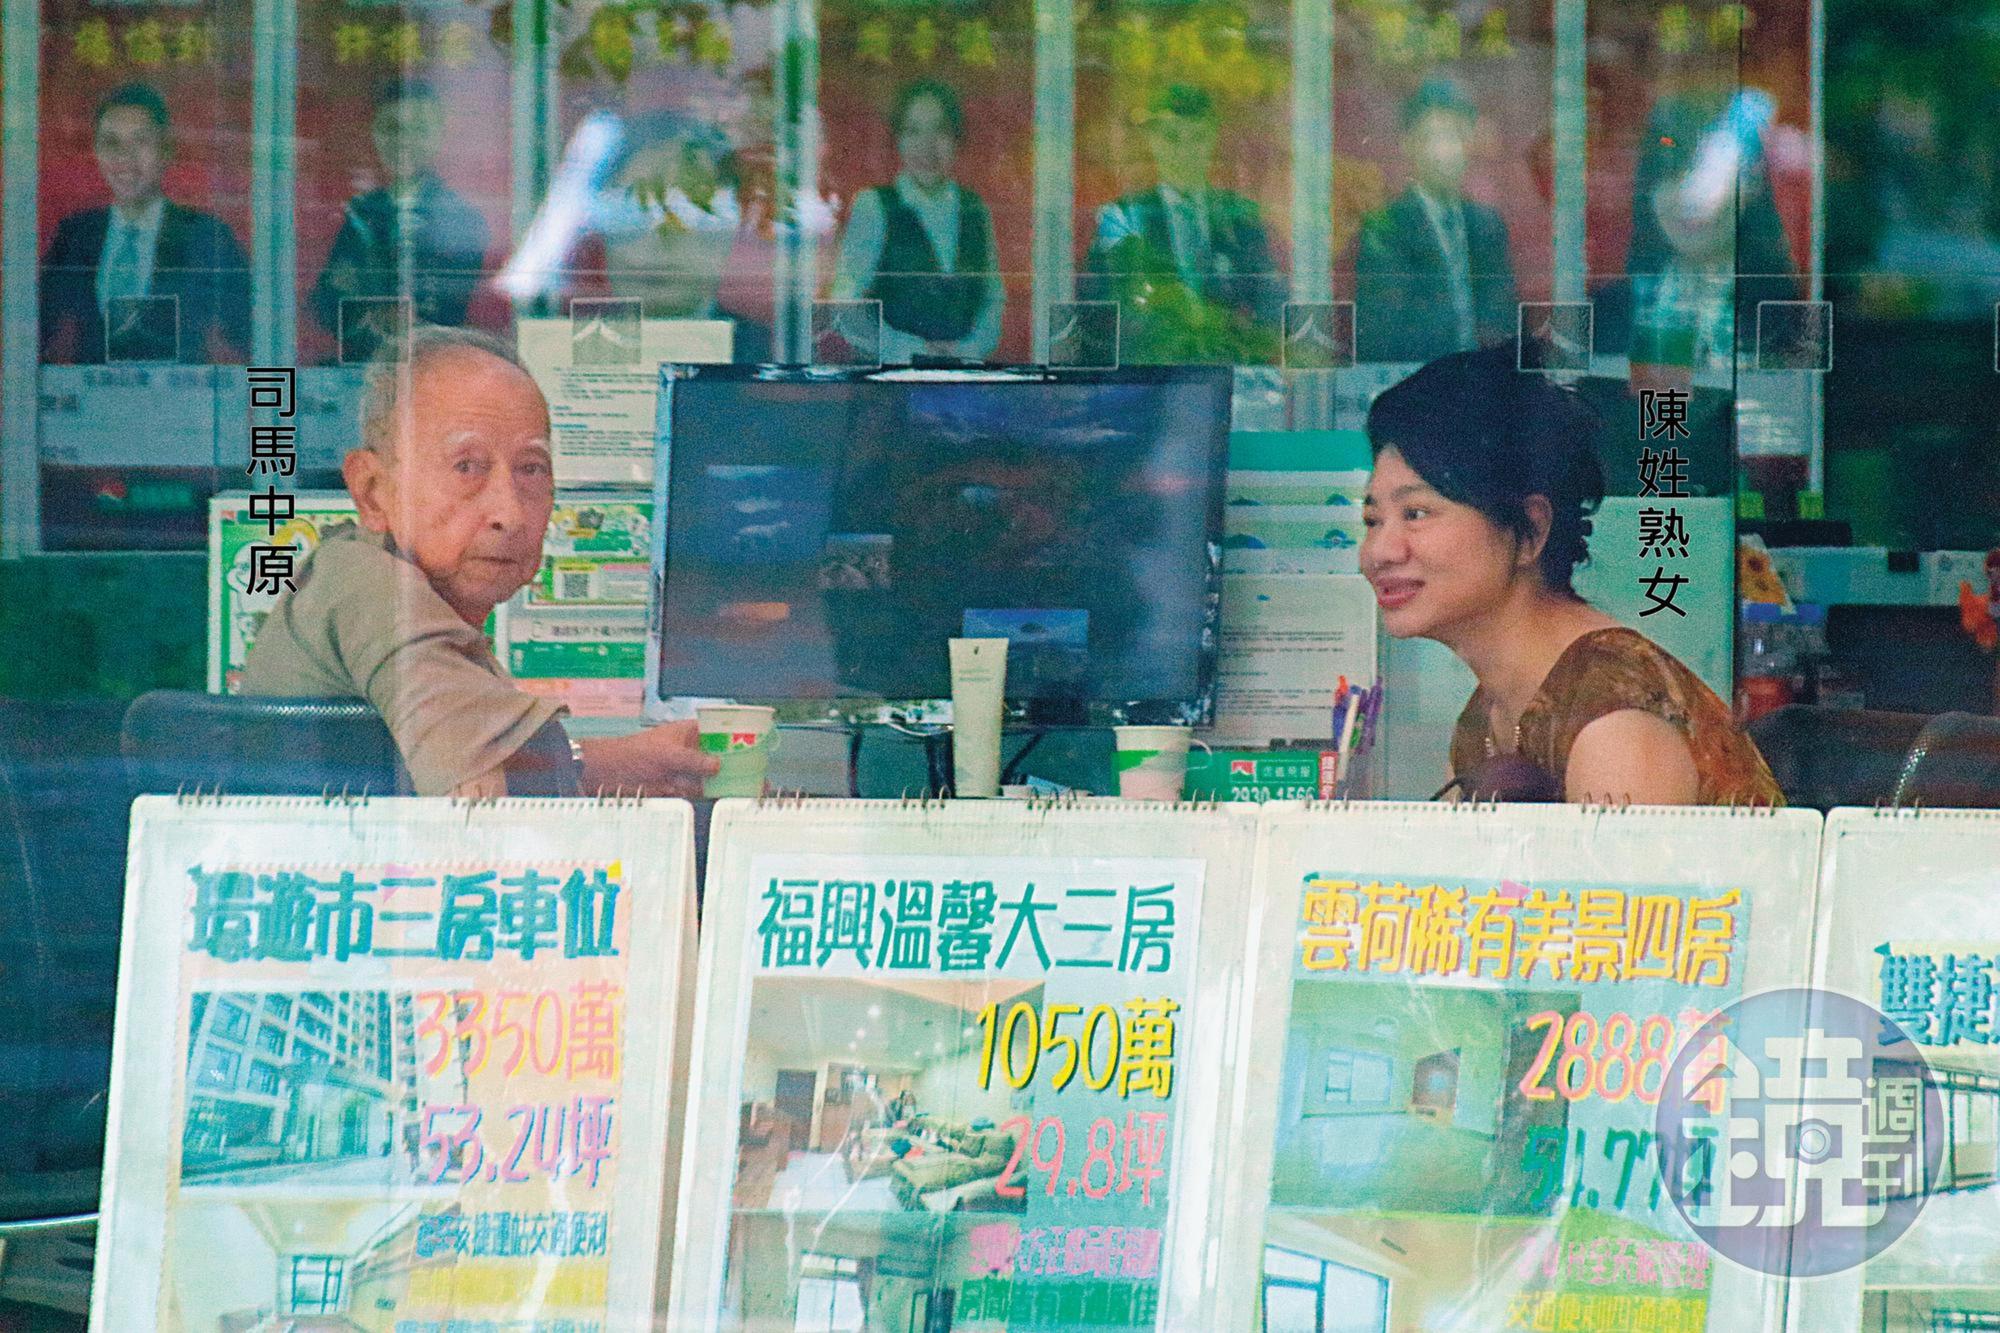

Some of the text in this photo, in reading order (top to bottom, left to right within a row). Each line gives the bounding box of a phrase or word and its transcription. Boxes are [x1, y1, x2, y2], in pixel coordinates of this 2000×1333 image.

[757, 878, 1177, 974] 福興溫馨大三房
[1301, 878, 1743, 987] 雲荷稀有美景四房
[415, 979, 624, 1084] 3350萬
[975, 997, 1181, 1099] 1050萬
[1878, 951, 2000, 1047] 雙捷
[994, 1111, 1169, 1206] 29.8坪
